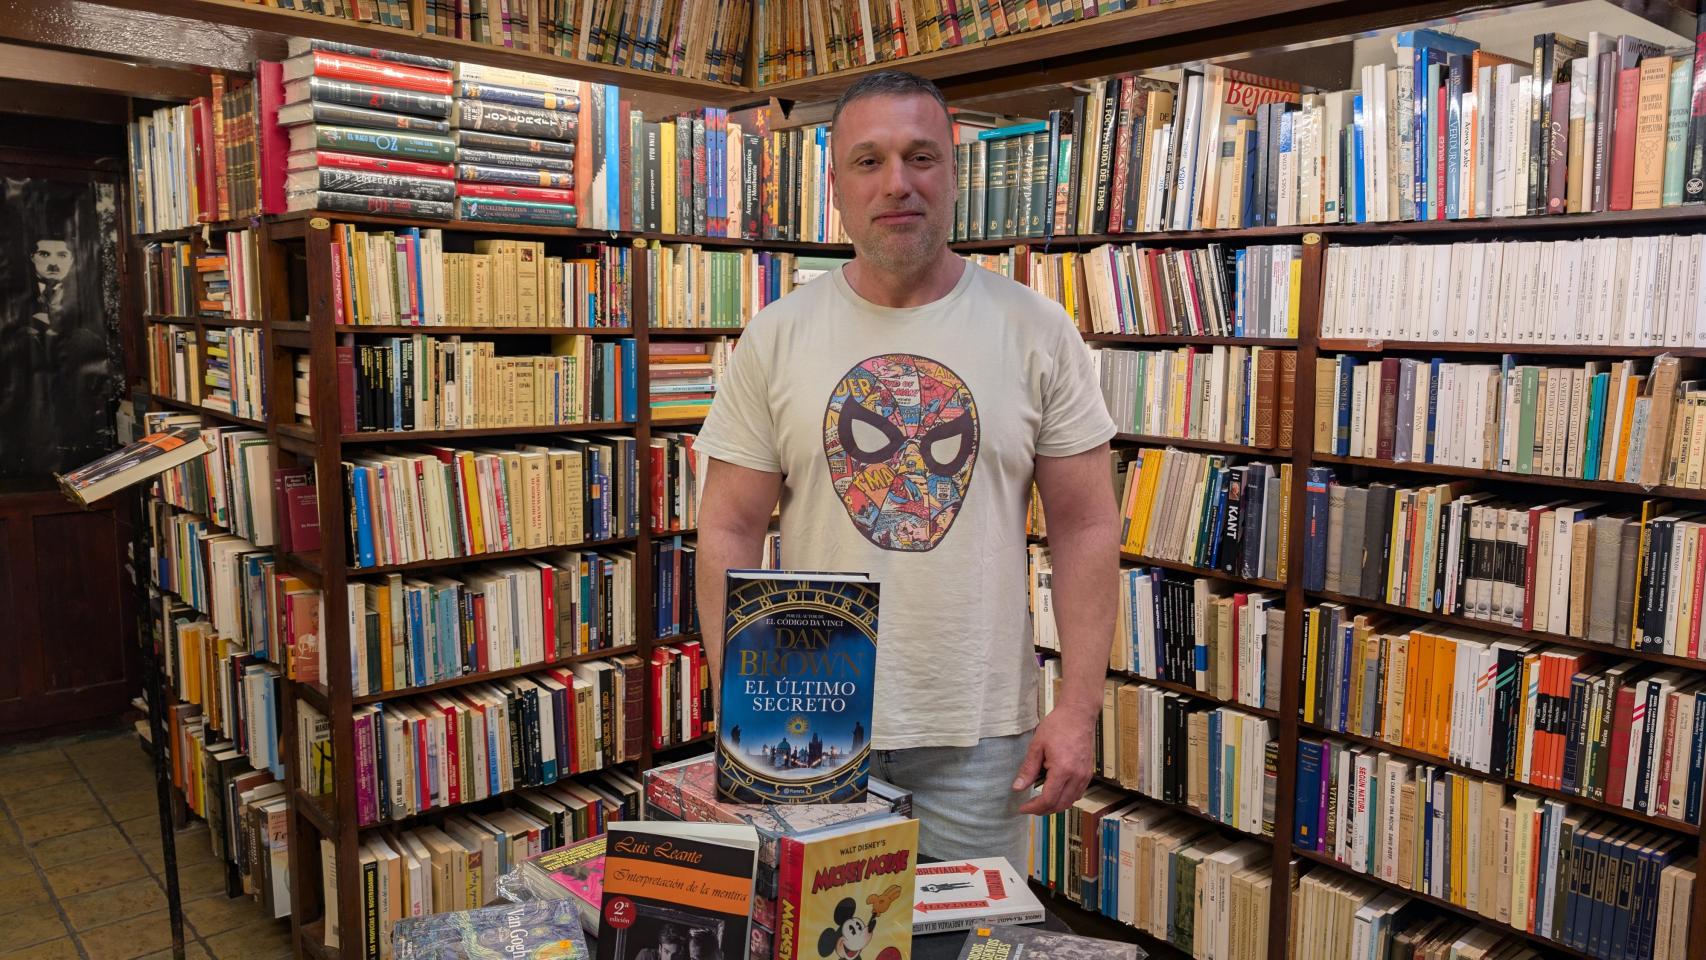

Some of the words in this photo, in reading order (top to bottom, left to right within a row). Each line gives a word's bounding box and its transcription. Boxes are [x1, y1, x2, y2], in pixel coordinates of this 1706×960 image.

[1105, 97, 1113, 107] EL
[484, 113, 558, 127] LOVECRAFT
[1103, 107, 1112, 125] FOC
[1159, 112, 1169, 121] DE
[376, 134, 399, 152] OZ
[1100, 143, 1109, 167] RODA
[1448, 120, 1458, 174] VERDURAS
[1550, 120, 1564, 166] Chocolate
[1280, 153, 1288, 170] CITAS
[356, 175, 403, 186] LOVECRAFT
[1099, 168, 1108, 184] DEL
[1096, 186, 1105, 212] TEMPS
[1339, 372, 1349, 411] PETRONIO
[1428, 375, 1438, 415] PETRONIO
[1548, 382, 1556, 417] COMEDIAS
[1558, 382, 1567, 417] COMEDIAS
[1570, 382, 1578, 417] COMEDIAS
[1415, 406, 1423, 433] ANALES
[1226, 506, 1239, 540] KANT
[776, 617, 809, 627] CÓDIGO
[810, 619, 821, 627] DA
[821, 619, 844, 627] VINCI
[775, 627, 834, 650] DAN
[738, 648, 865, 678] BROWN
[745, 680, 769, 695] EL
[776, 676, 856, 697] ÚLTIMO
[691, 697, 699, 720] JAPÓN
[752, 697, 846, 712] SECRETO
[1327, 786, 1337, 833] BACANALIA
[614, 836, 650, 855] Luis
[653, 841, 703, 864] Leante
[840, 845, 857, 856] WALT
[857, 839, 887, 851] DISNEY'S
[811, 857, 867, 894] MICKEY
[864, 849, 910, 879] MOUSE
[916, 866, 961, 876] BREVIADA
[366, 870, 374, 909] NOSTRADAMUS
[612, 868, 687, 890] Interpretación
[686, 880, 697, 893] de
[699, 883, 709, 895] la
[712, 887, 747, 902] mentira
[507, 908, 525, 928] Van
[609, 915, 631, 925] edición
[937, 919, 963, 930] ABREVIADA
[368, 917, 376, 944] PROFECÍAS
[505, 928, 532, 960] Gogh
